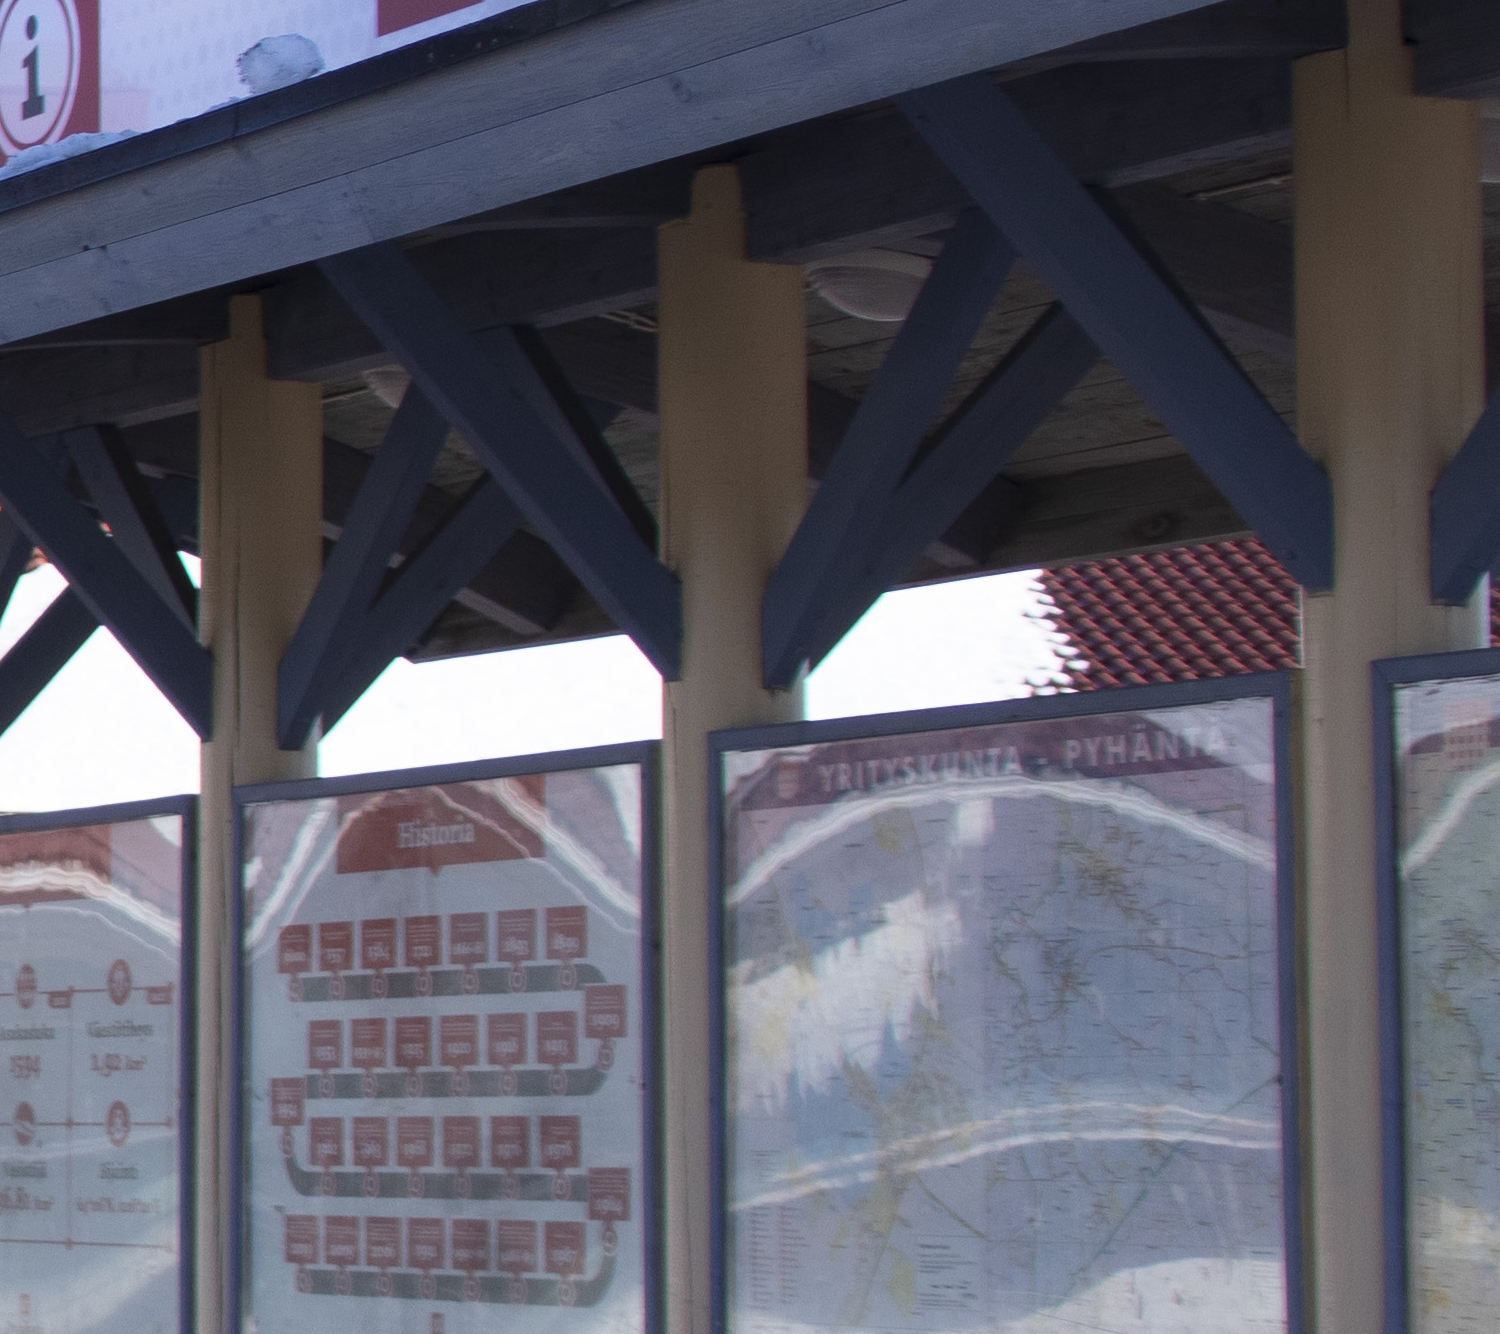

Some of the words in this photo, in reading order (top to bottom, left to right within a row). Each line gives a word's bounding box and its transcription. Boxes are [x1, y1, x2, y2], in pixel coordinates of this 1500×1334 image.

[816, 744, 1024, 795] YRITYSKUNTA
[1063, 720, 1232, 772] PYHÄNTÄ
[396, 815, 476, 850] Historia
